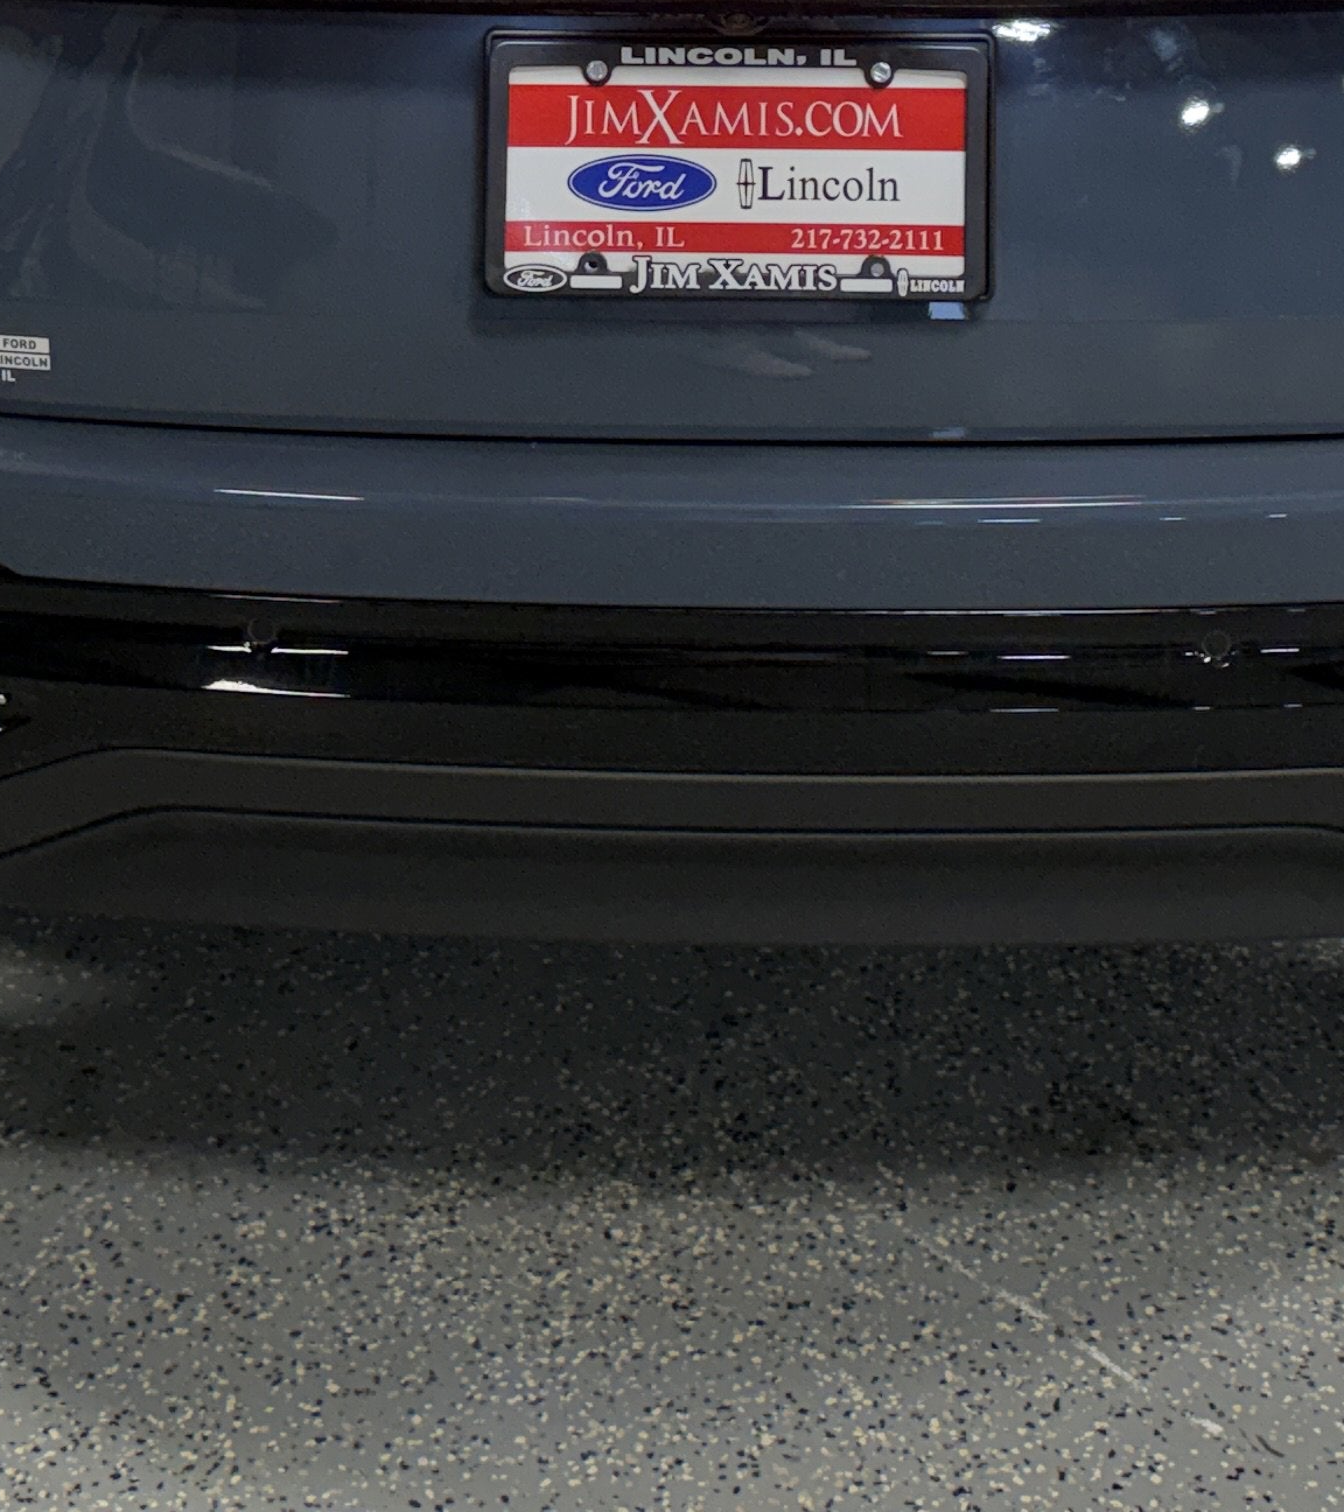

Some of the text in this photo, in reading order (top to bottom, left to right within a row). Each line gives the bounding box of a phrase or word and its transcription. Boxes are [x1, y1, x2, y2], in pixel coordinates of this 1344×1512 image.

[620, 46, 857, 67] LINCOLN, IL
[564, 89, 902, 145] JIMXAMIS.COM
[598, 163, 686, 201] Ford
[757, 165, 900, 202] Lincoln
[523, 223, 685, 250] Lincoln, IL
[791, 228, 944, 251] 217-732-2111
[516, 270, 554, 288] Ford
[629, 255, 838, 294] JIM XAMIS
[909, 279, 965, 293] LINCOLN
[2, 337, 37, 350] FORD
[0, 370, 17, 383] IL
